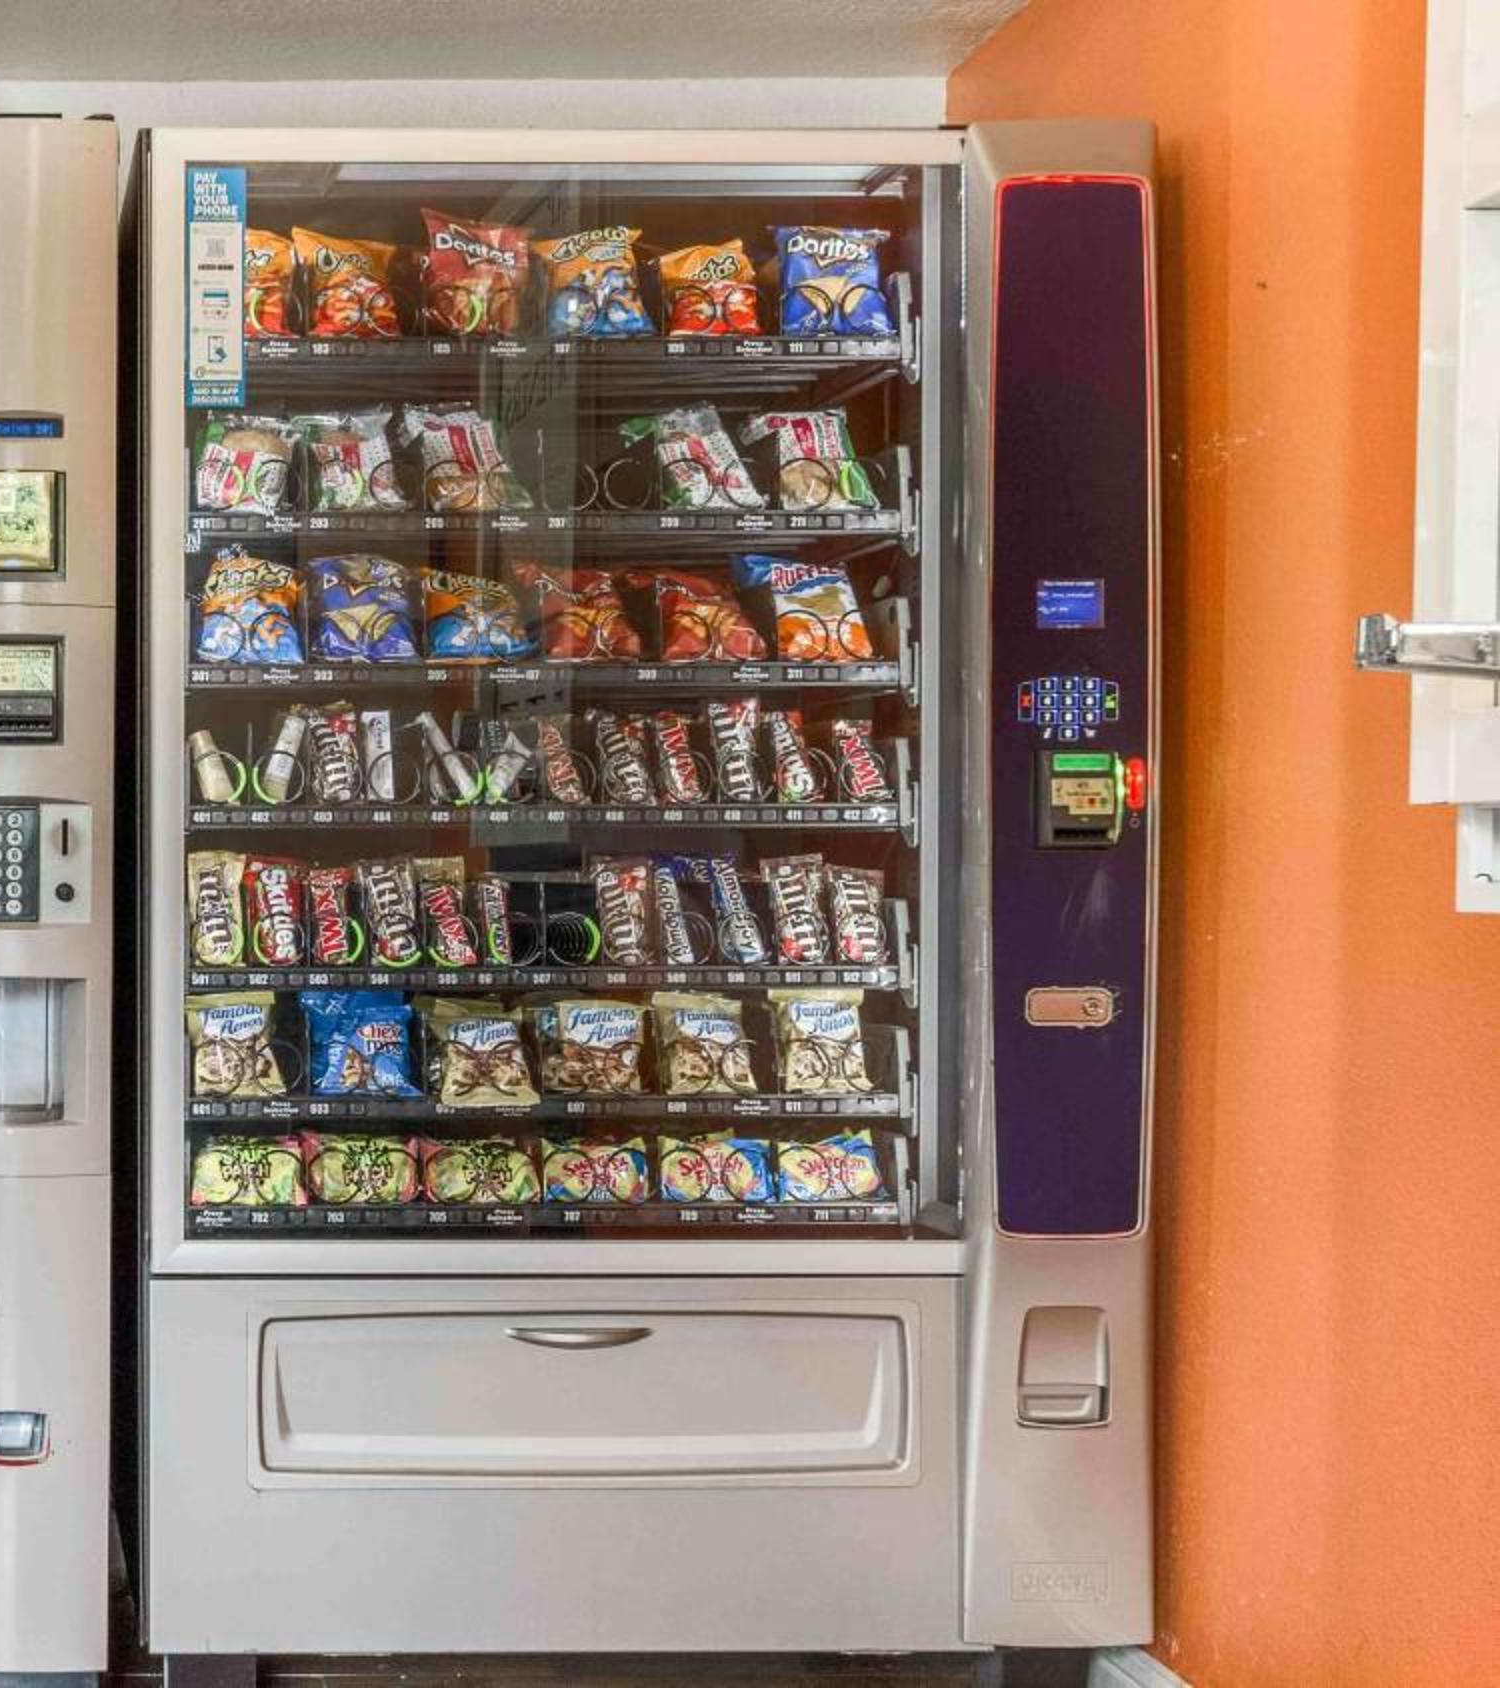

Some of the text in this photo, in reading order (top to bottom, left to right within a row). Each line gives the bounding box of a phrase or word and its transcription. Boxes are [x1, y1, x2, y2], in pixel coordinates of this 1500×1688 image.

[194, 172, 218, 183] PAY
[194, 183, 228, 194] WITH
[194, 194, 229, 205] YOUR
[194, 204, 239, 216] PHONE
[434, 232, 516, 267] Doritos
[786, 233, 869, 260] Doritos
[259, 867, 297, 960] Skittles
[202, 1003, 264, 1023] Famous
[567, 1006, 638, 1029] Famous
[220, 1016, 264, 1035] Amos
[698, 1020, 740, 1038] Amos
[810, 1014, 855, 1034] Amos
[470, 1026, 517, 1047] Amos
[587, 1025, 638, 1045] Amos
[219, 1163, 271, 1180] PATCH
